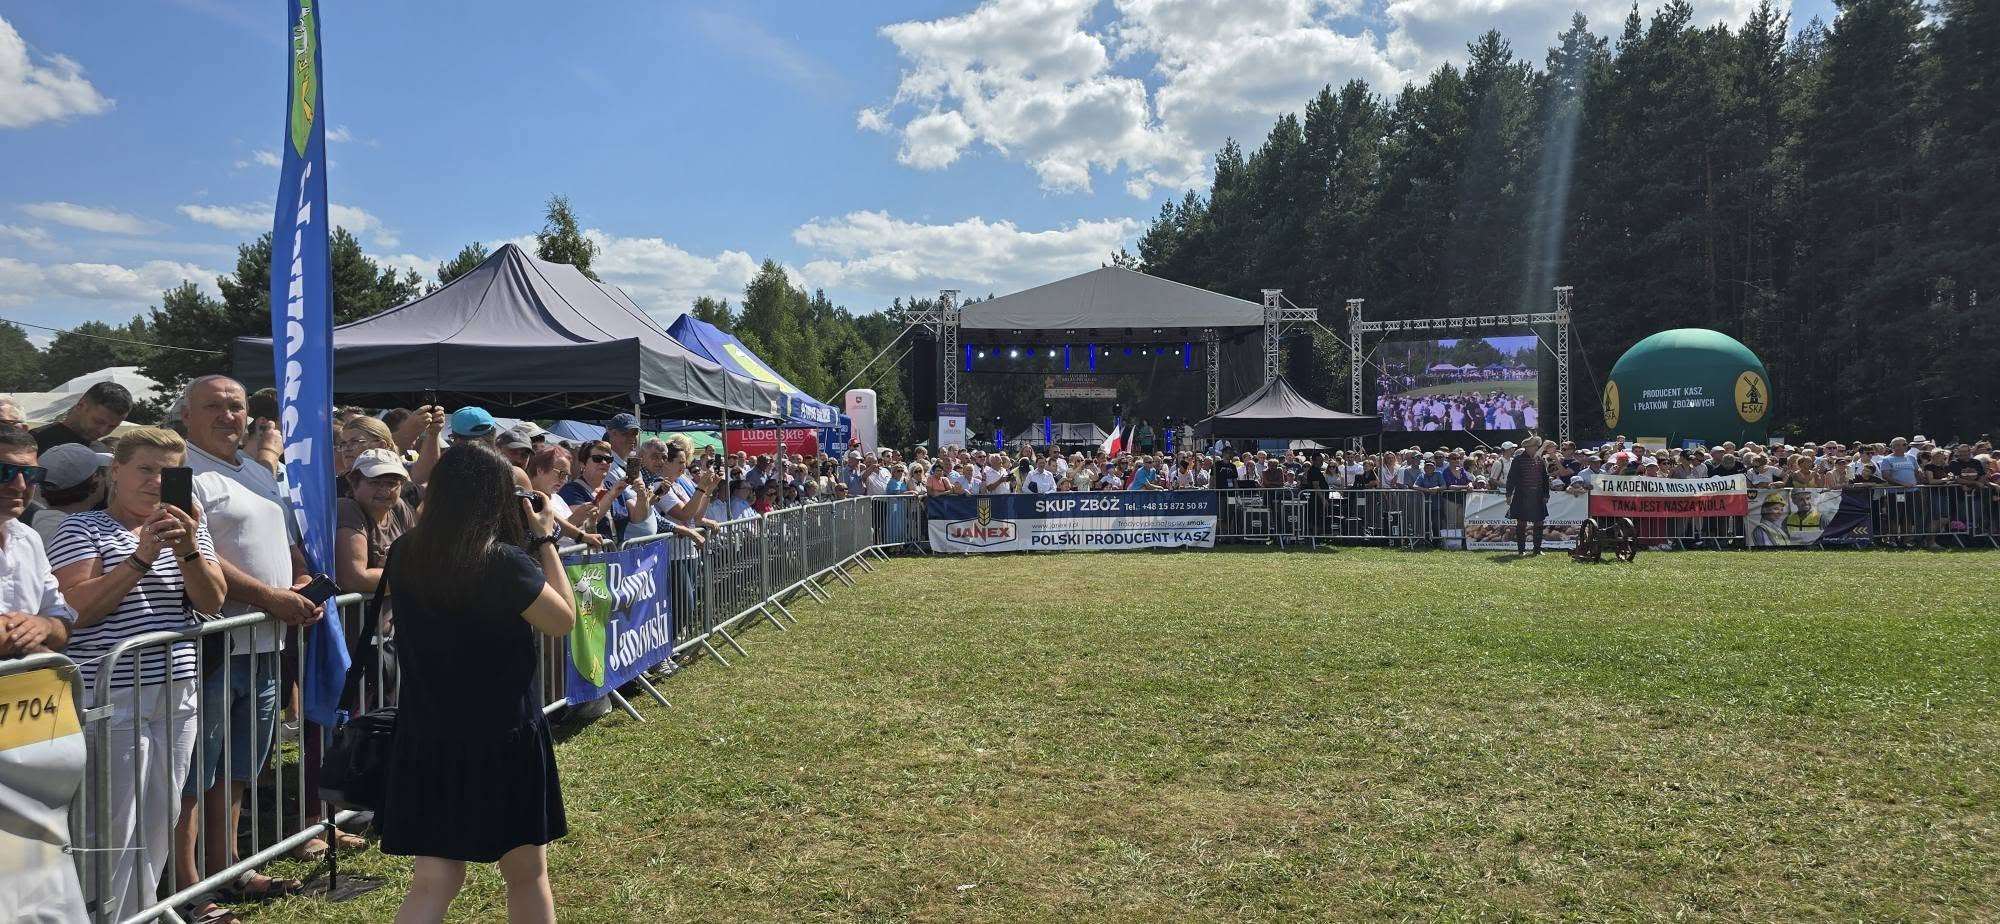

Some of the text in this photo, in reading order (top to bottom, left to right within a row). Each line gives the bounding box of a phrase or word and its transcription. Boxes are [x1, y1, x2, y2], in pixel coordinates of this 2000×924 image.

[1642, 387, 1703, 398] PRODUCENT KASZ
[1638, 400, 1668, 410] PŁATKÓW
[1741, 402, 1763, 414] ESKA
[1602, 479, 1736, 495] TA KADENCJA MISJĄ KAROLA
[1035, 499, 1076, 513] SKUP
[1080, 496, 1120, 511] ZBÓŻ
[1142, 502, 1157, 511] +48
[1158, 502, 1168, 511] 15
[1170, 502, 1185, 511] 872
[1186, 502, 1197, 510] 50
[1197, 502, 1208, 510] 87
[1611, 497, 1726, 512] TAKA JEST NASZA WOLA
[951, 524, 1010, 542] JANEX
[1031, 531, 1211, 546] POLSKI PRODUCENT KASZ
[609, 600, 669, 672] Janowski
[18, 694, 57, 721] 704
